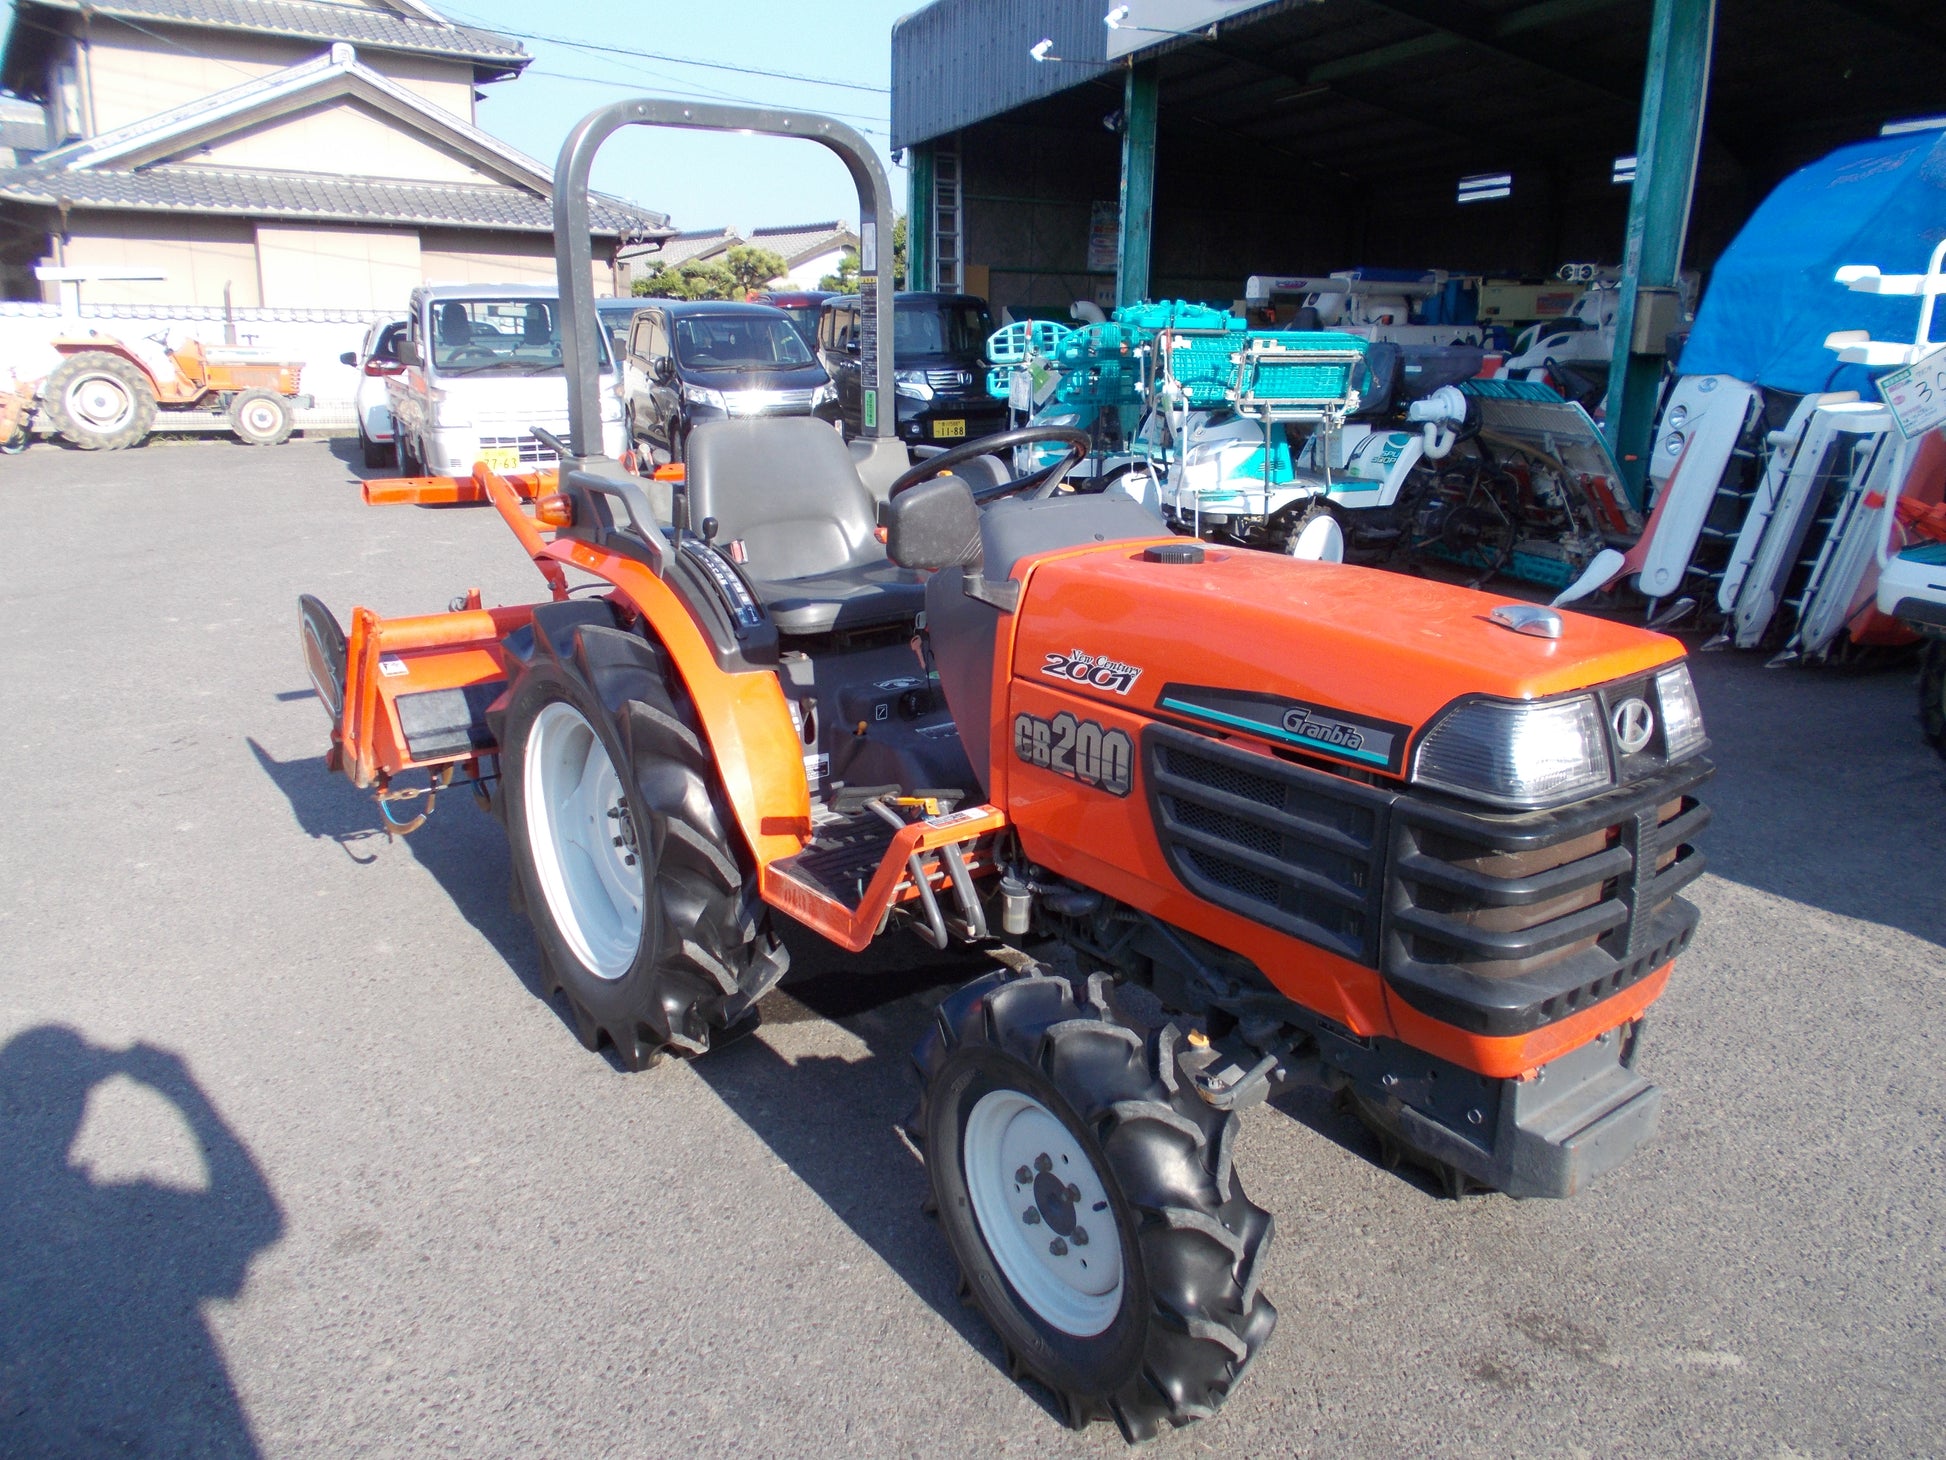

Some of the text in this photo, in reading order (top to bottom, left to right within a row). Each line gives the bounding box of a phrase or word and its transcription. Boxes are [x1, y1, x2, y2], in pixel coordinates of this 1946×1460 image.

[1042, 653, 1136, 695] 2001
[1070, 649, 1142, 677] New Century
[1282, 707, 1363, 750] Granbia
[1014, 712, 1133, 797] GB200
